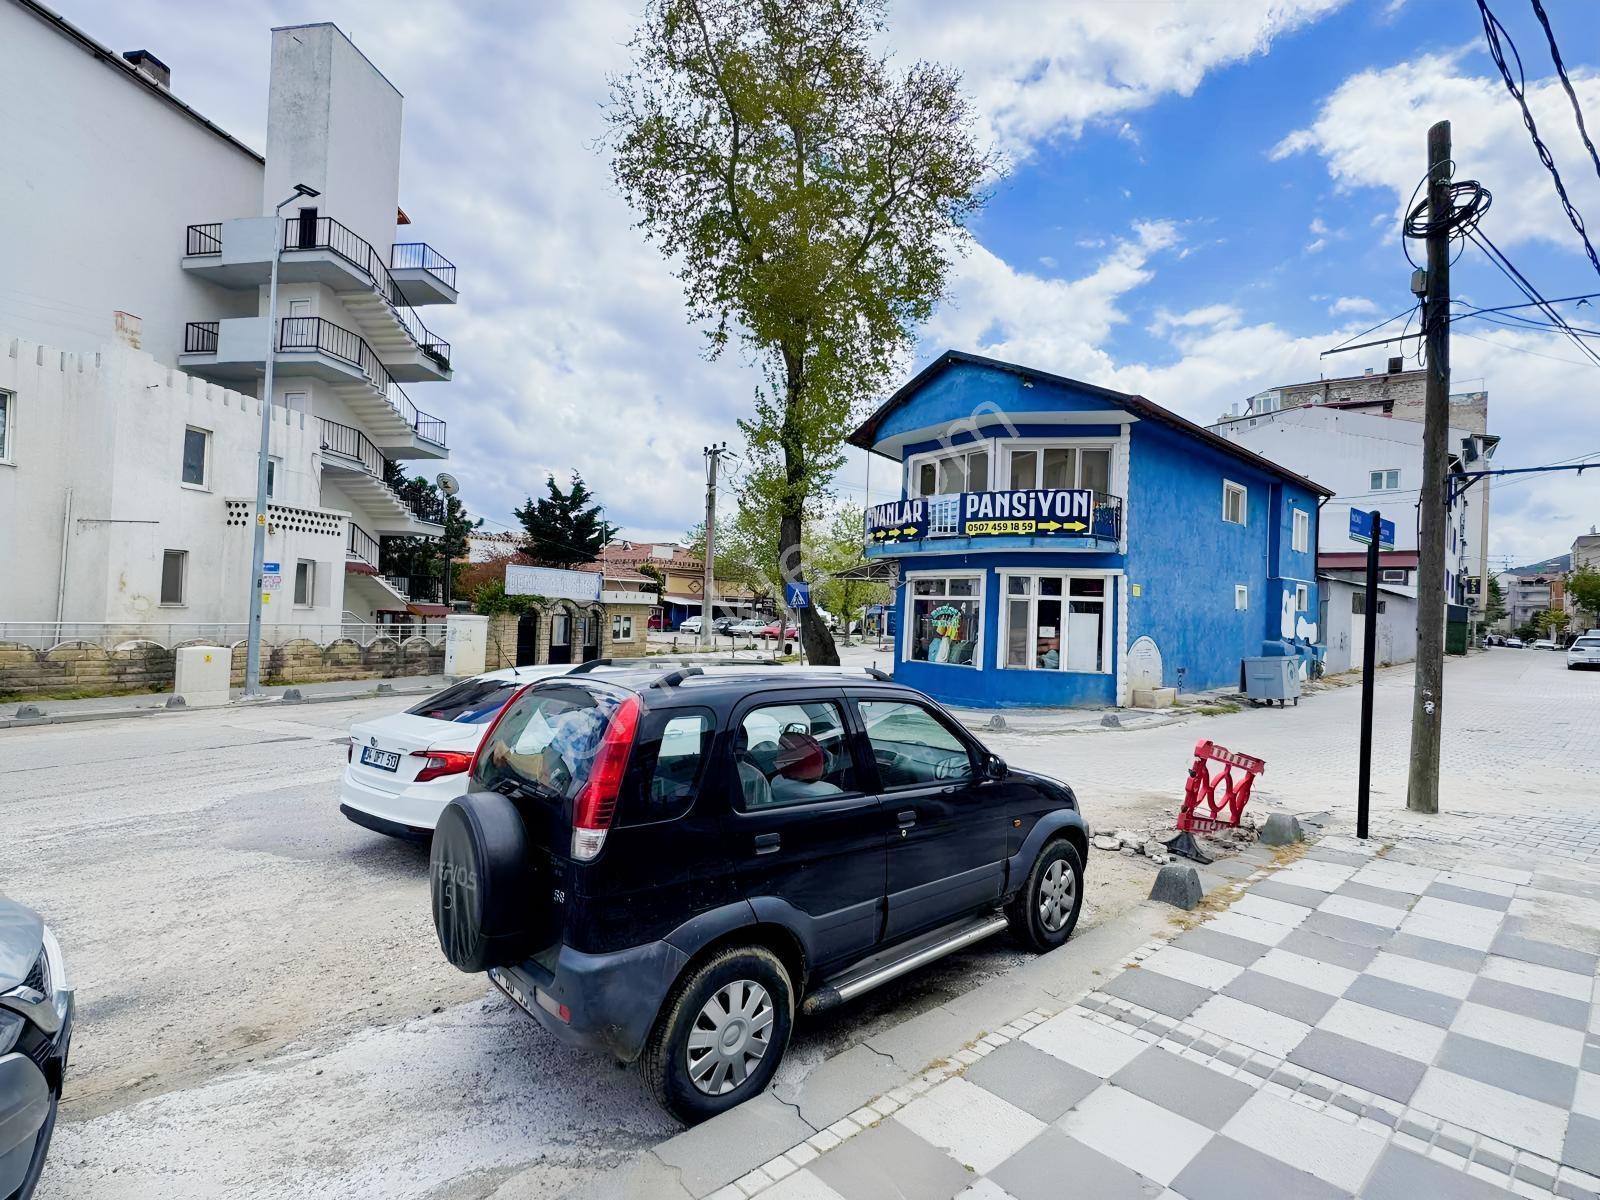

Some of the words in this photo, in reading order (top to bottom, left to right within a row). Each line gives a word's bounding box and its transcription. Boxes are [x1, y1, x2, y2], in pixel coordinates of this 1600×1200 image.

[967, 522, 989, 532] 0507
[991, 522, 1008, 531] 459
[1011, 522, 1020, 531] 18
[1022, 522, 1033, 531] 59
